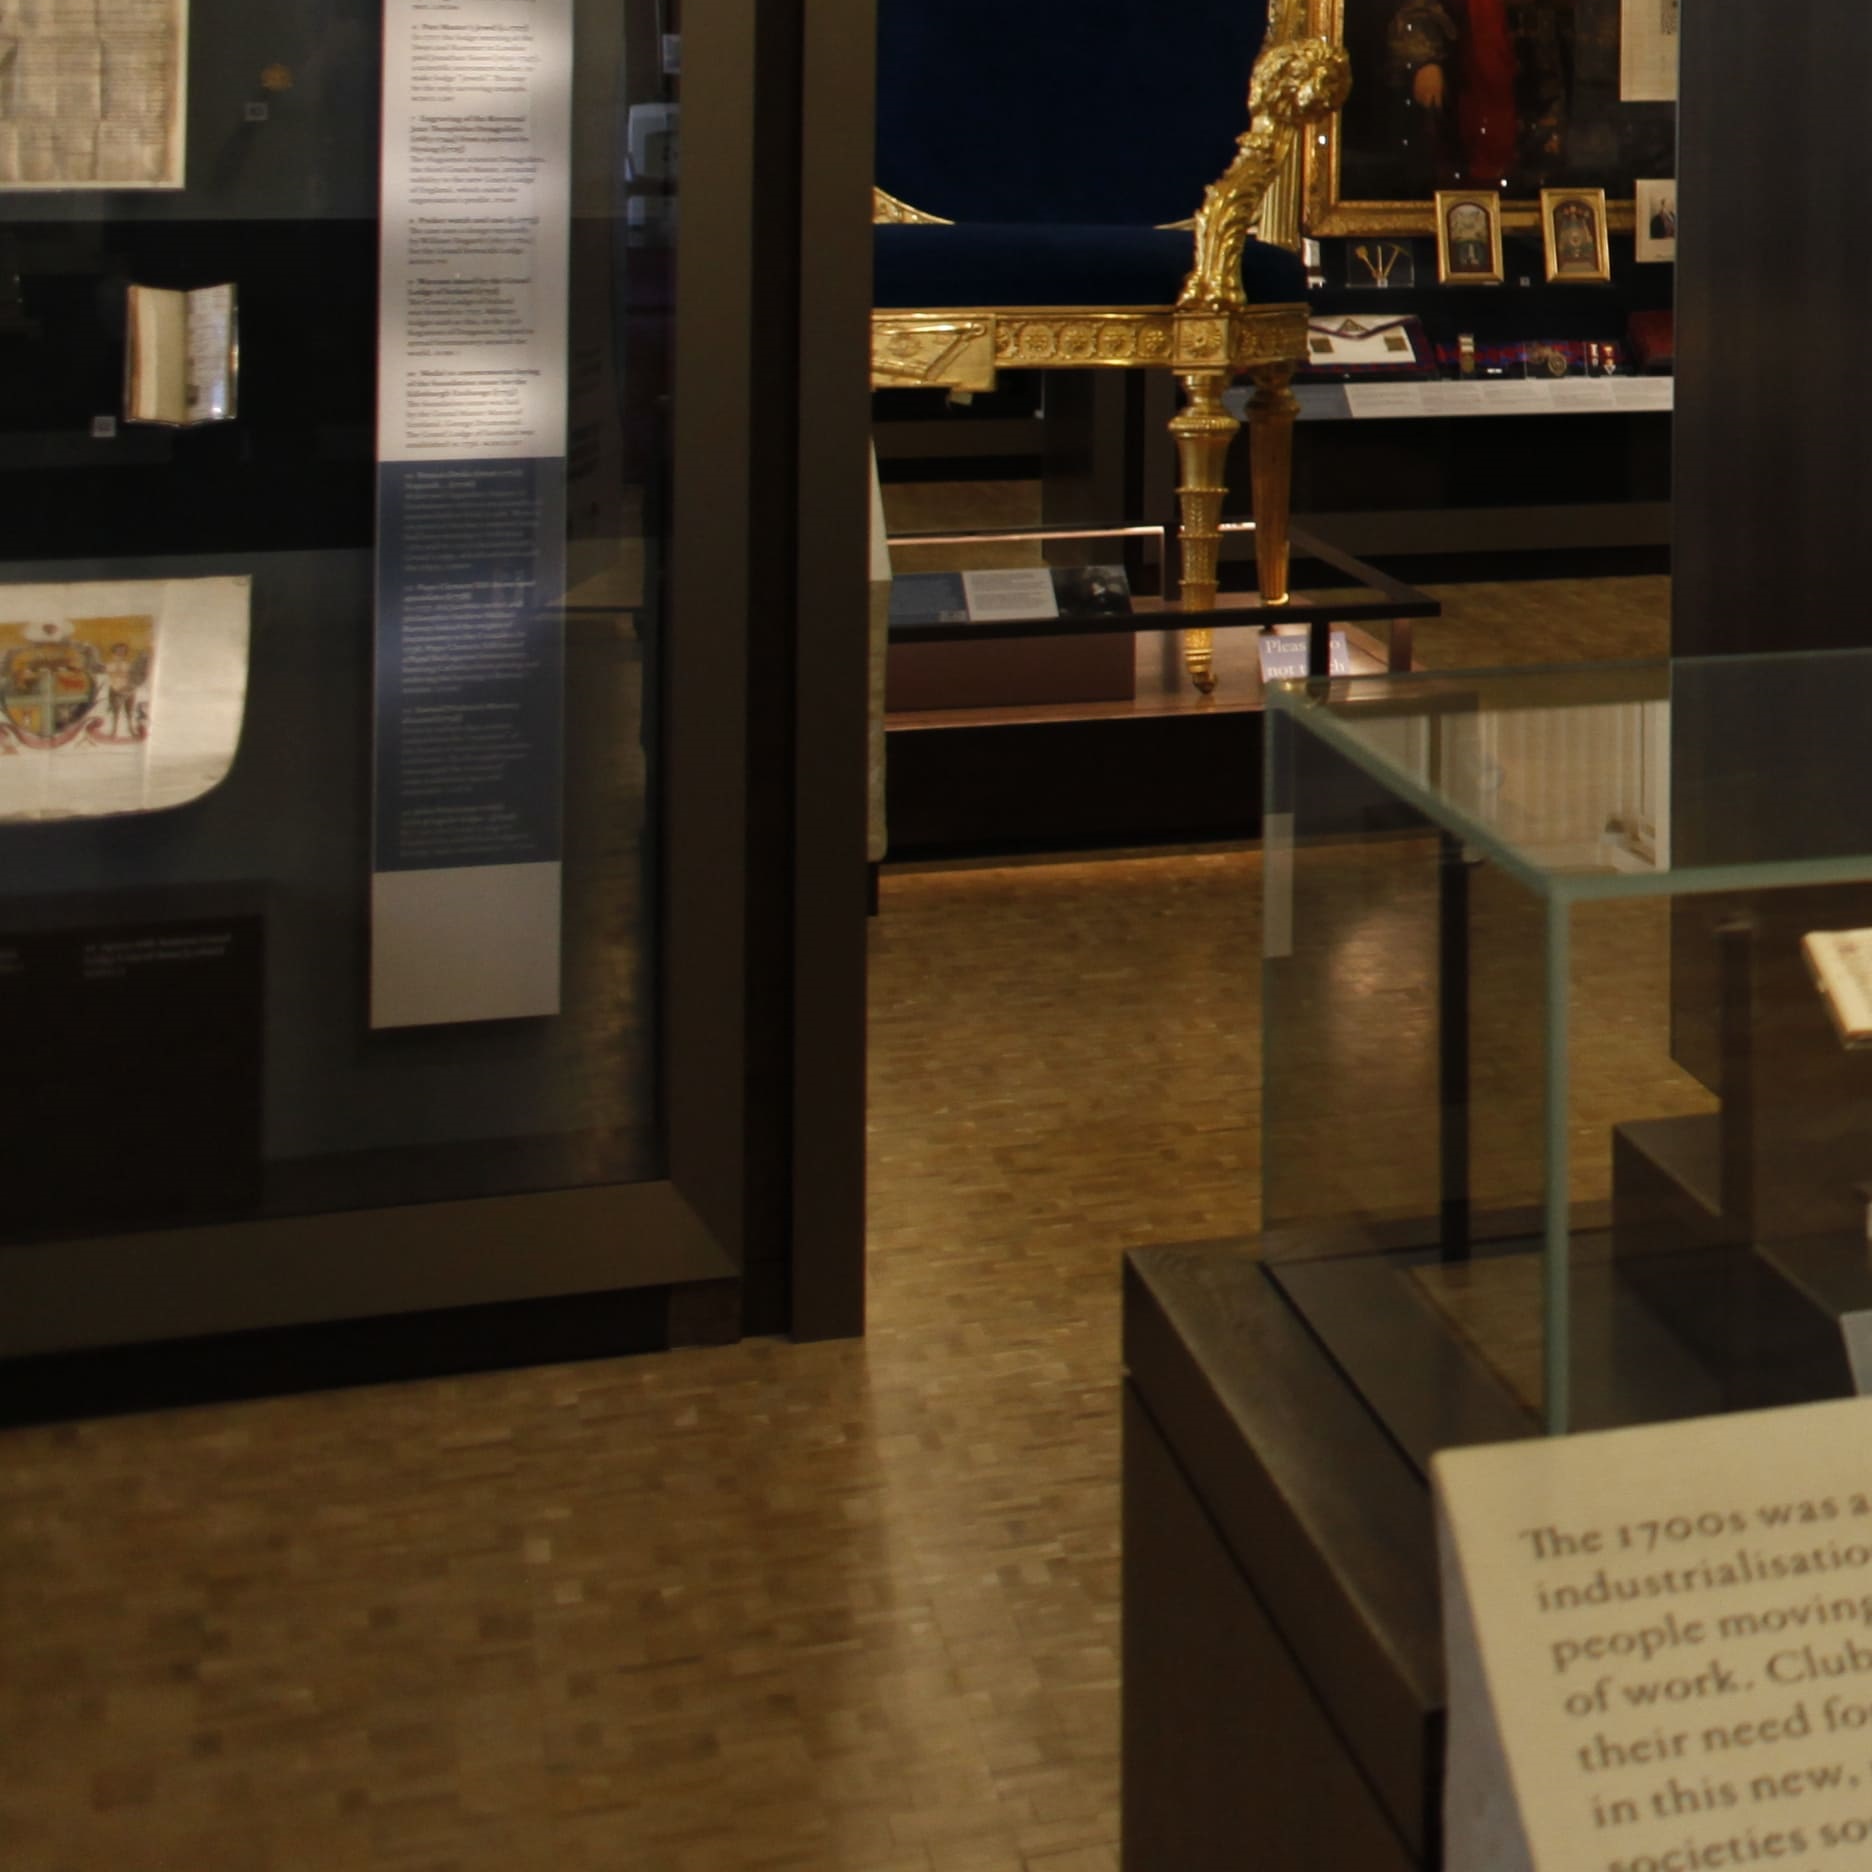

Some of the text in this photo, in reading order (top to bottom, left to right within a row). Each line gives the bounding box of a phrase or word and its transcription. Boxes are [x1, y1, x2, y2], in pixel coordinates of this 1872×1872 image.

[1267, 664, 1295, 676] not
[1522, 1525, 1604, 1560] The
[1617, 1510, 1747, 1552] 1700s
[1756, 1493, 1840, 1527] was
[1850, 1493, 1871, 1517] a
[1551, 1614, 1706, 1673] people
[1563, 1677, 1612, 1718] of
[1623, 1660, 1755, 1708] work.
[1578, 1732, 1690, 1774] their
[1703, 1701, 1812, 1753] need
[1593, 1795, 1639, 1828] in
[1651, 1776, 1738, 1819] this
[1751, 1763, 1860, 1804] new,
[1608, 1823, 1813, 1872] societies
